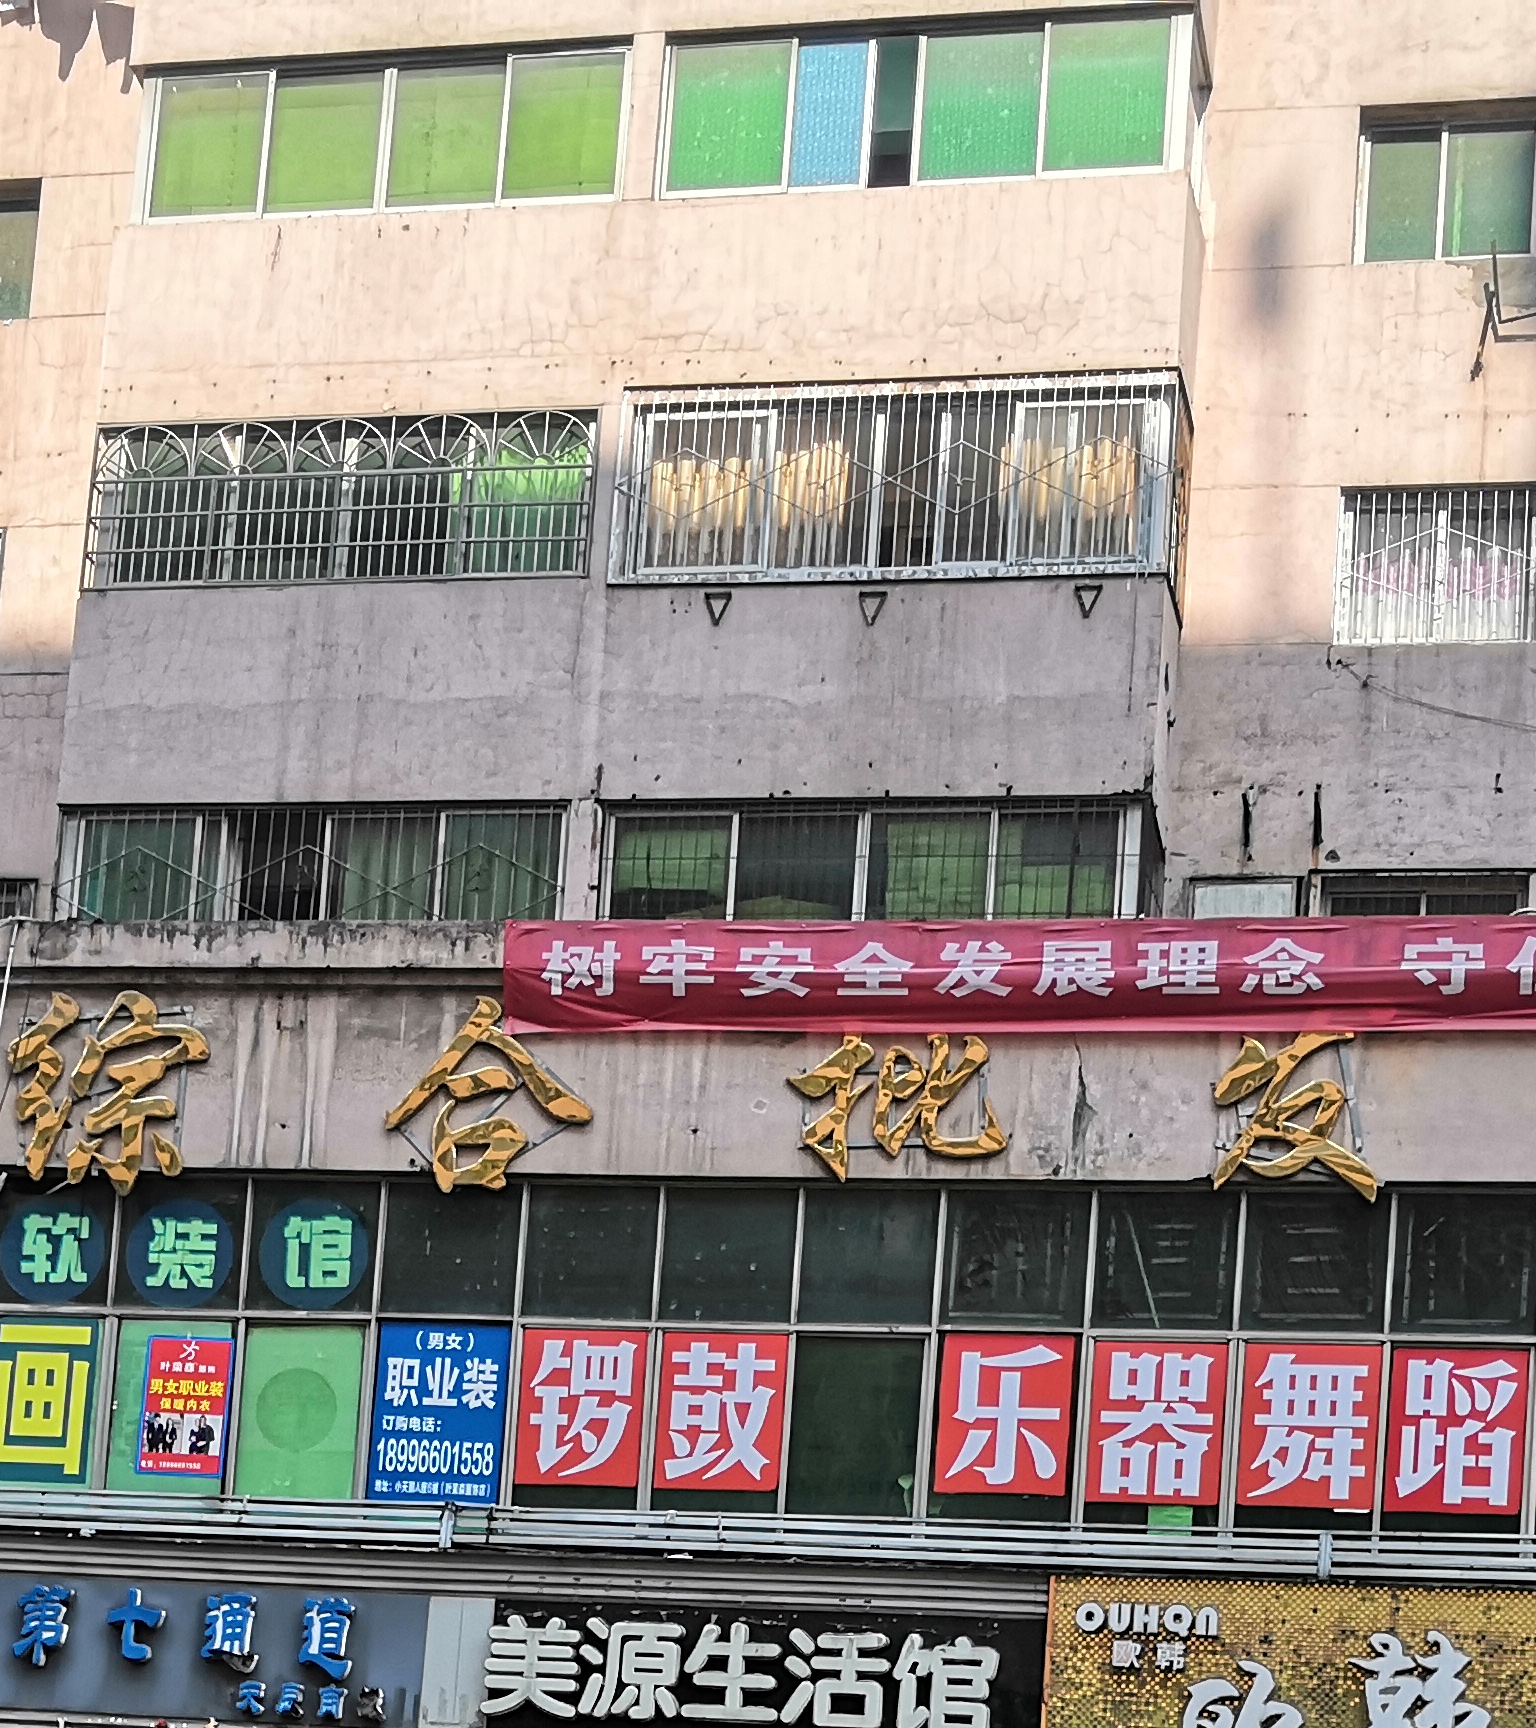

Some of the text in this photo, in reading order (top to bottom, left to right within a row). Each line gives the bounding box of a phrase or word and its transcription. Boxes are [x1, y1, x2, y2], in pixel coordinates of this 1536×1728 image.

[541, 936, 1326, 998] 树牢安全发展理念
[19, 1212, 353, 1291] 软装馆
[149, 1378, 225, 1398] 男女职业装
[384, 1357, 499, 1410] 职业装
[529, 1339, 778, 1483] 锣鼓
[944, 1344, 1520, 1502] 乐器舞蹈
[376, 1437, 494, 1476] 18996601558
[1112, 1640, 1187, 1671] 欧韩
